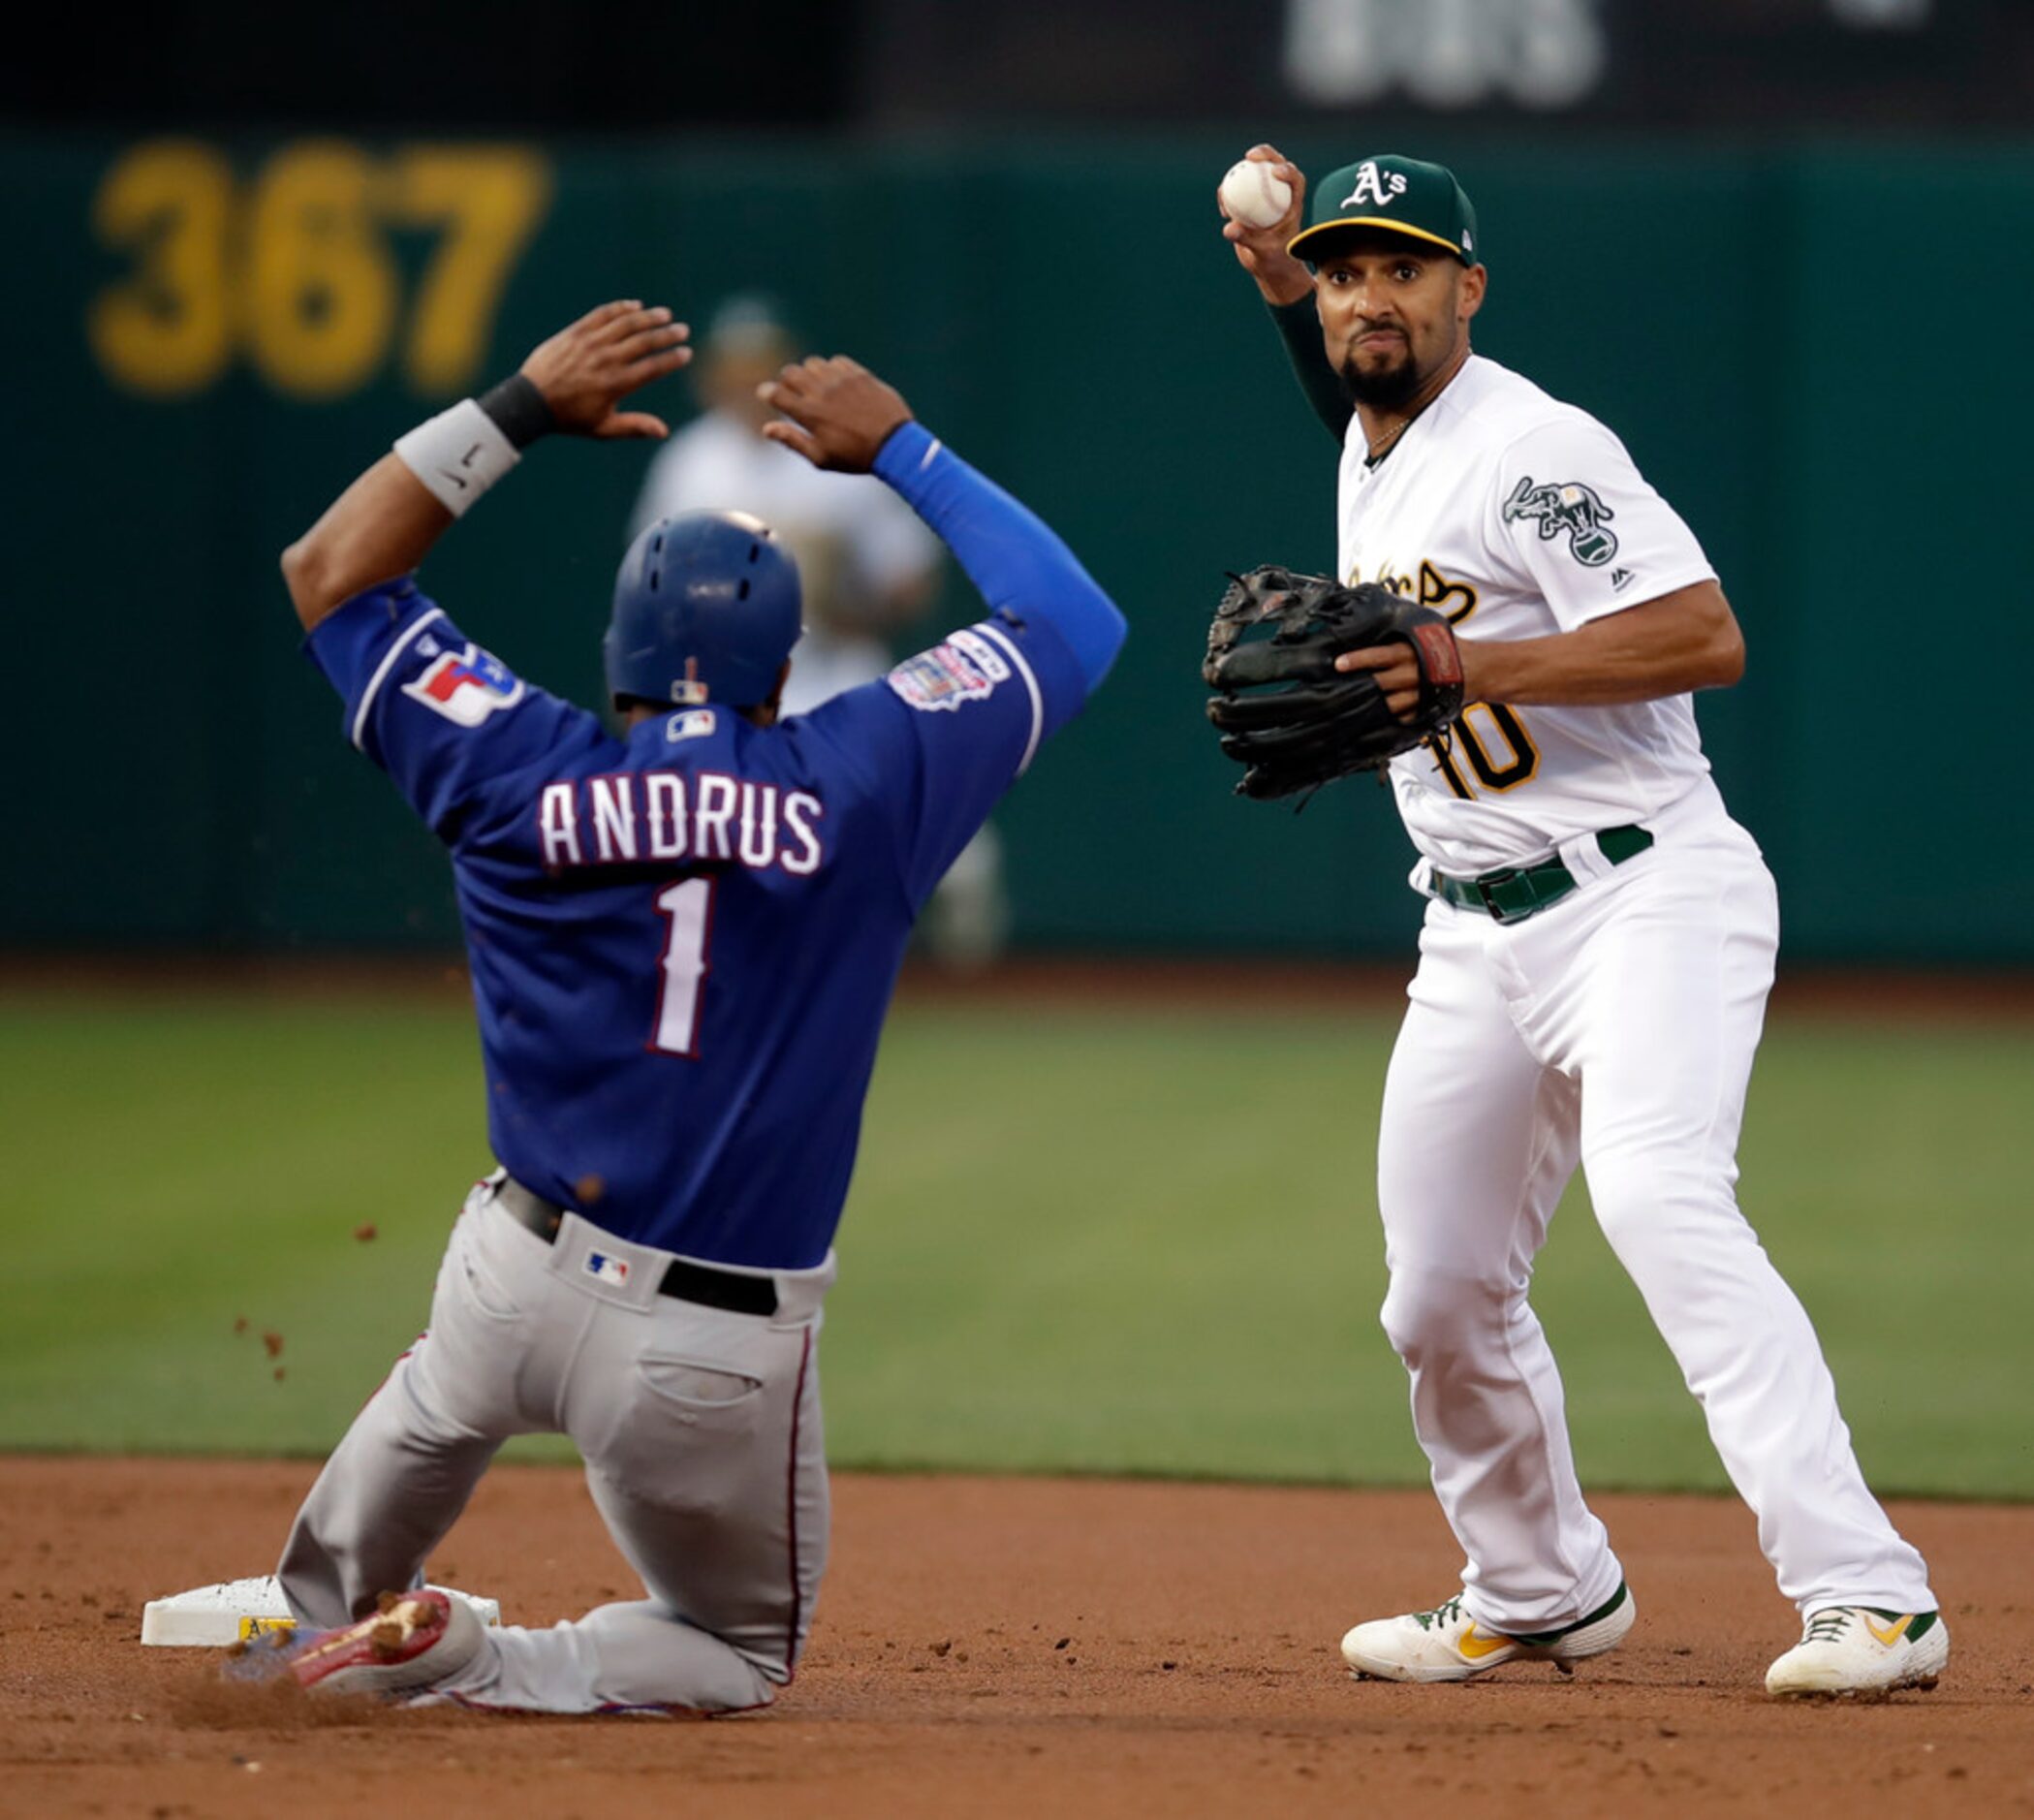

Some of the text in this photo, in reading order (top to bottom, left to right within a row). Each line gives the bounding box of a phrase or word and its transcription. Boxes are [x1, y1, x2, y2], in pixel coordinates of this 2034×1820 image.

[1340, 160, 1407, 209] A's
[93, 140, 550, 397] 367
[1428, 700, 1543, 800] 10
[538, 770, 824, 877] ANDRUS
[645, 874, 717, 1058] 1
